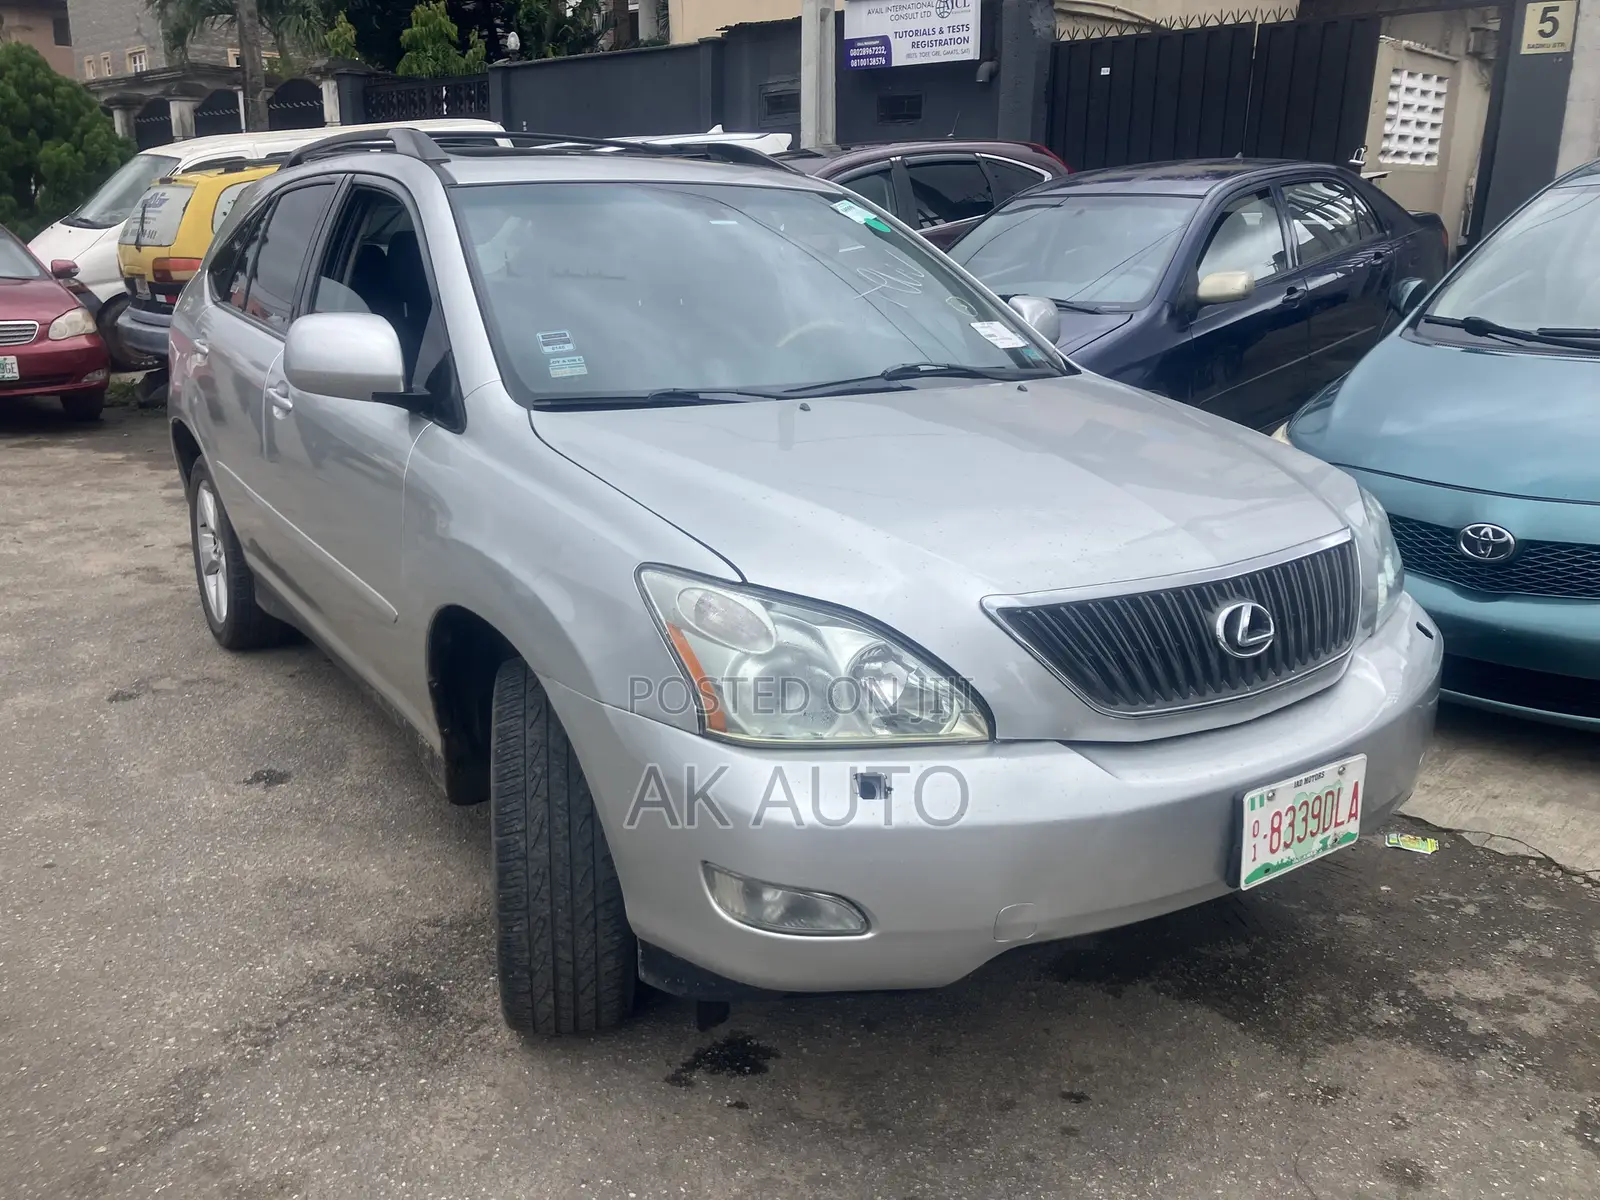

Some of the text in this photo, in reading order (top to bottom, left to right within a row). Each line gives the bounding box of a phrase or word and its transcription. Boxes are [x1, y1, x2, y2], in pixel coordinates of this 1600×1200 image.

[867, 1, 934, 16] AVAIL INTERNATIONAL
[890, 11, 931, 22] CONSULT LTD
[1538, 6, 1559, 38] 5
[894, 23, 970, 39] TUTORIALS & TESTS
[911, 36, 969, 49] REGISTRATION
[1304, 771, 1325, 785] MOTORS
